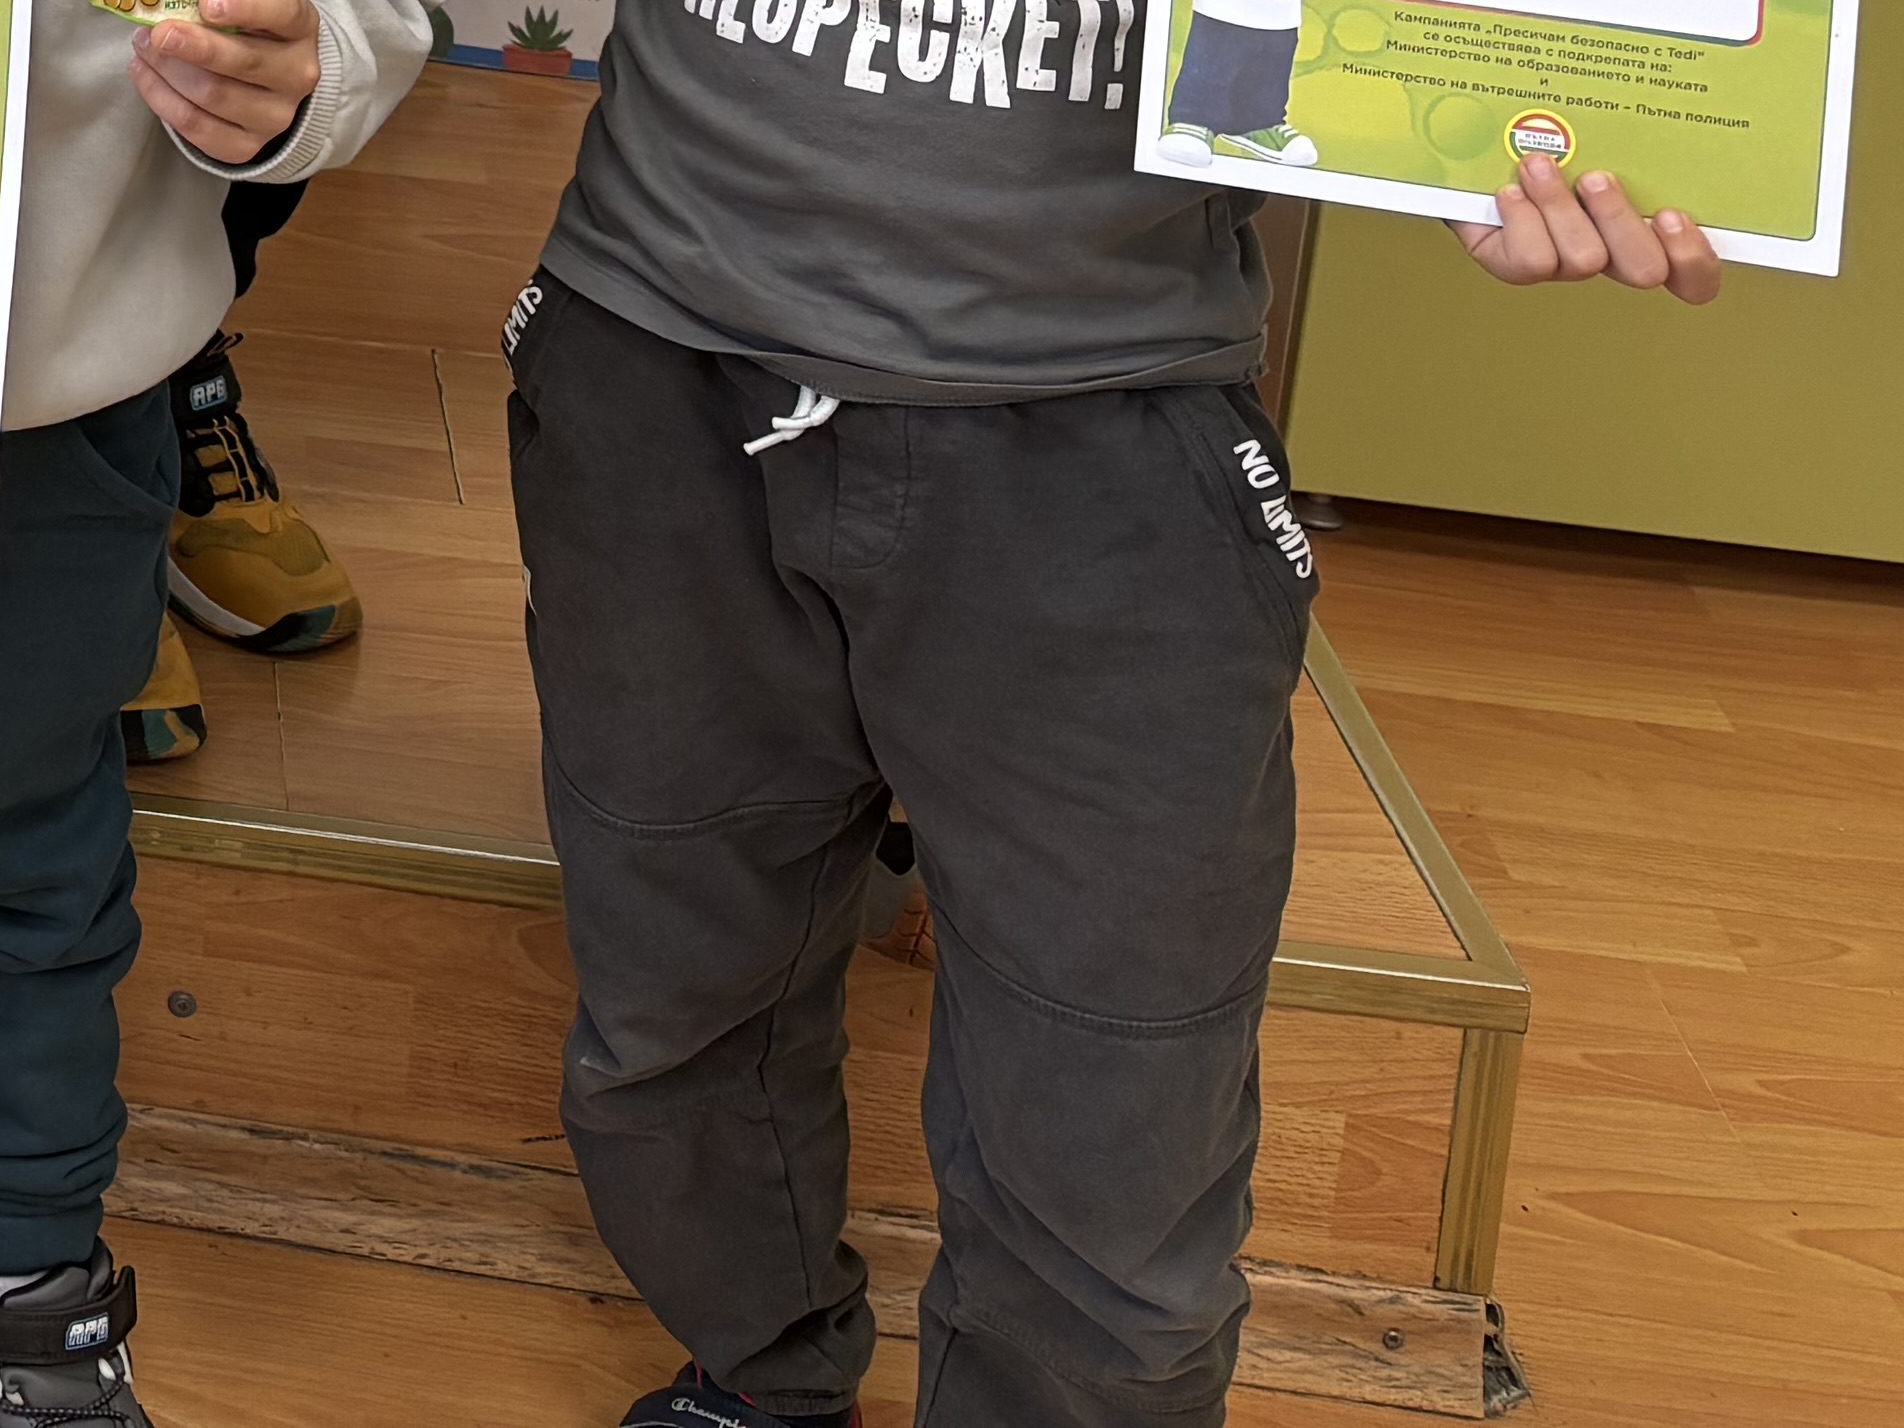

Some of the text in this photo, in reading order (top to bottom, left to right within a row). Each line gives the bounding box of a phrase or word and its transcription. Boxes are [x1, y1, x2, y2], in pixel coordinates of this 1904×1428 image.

[1394, 10, 1480, 31] Кампанията
[1570, 34, 1649, 54] безопасно
[1443, 34, 1541, 55] осъществява
[1557, 49, 1645, 69] подкрепата
[1650, 62, 1671, 72] на:
[1386, 39, 1490, 62] Министерство
[1516, 58, 1630, 82] образованието
[1649, 77, 1707, 92] науката
[1342, 62, 1446, 86] Министерство
[1471, 82, 1561, 102] вътрешните
[1565, 96, 1619, 110] работи
[1636, 103, 1680, 119] Пътна
[1685, 112, 1749, 127] полиция
[1233, 439, 1313, 579] NO LIMITS
